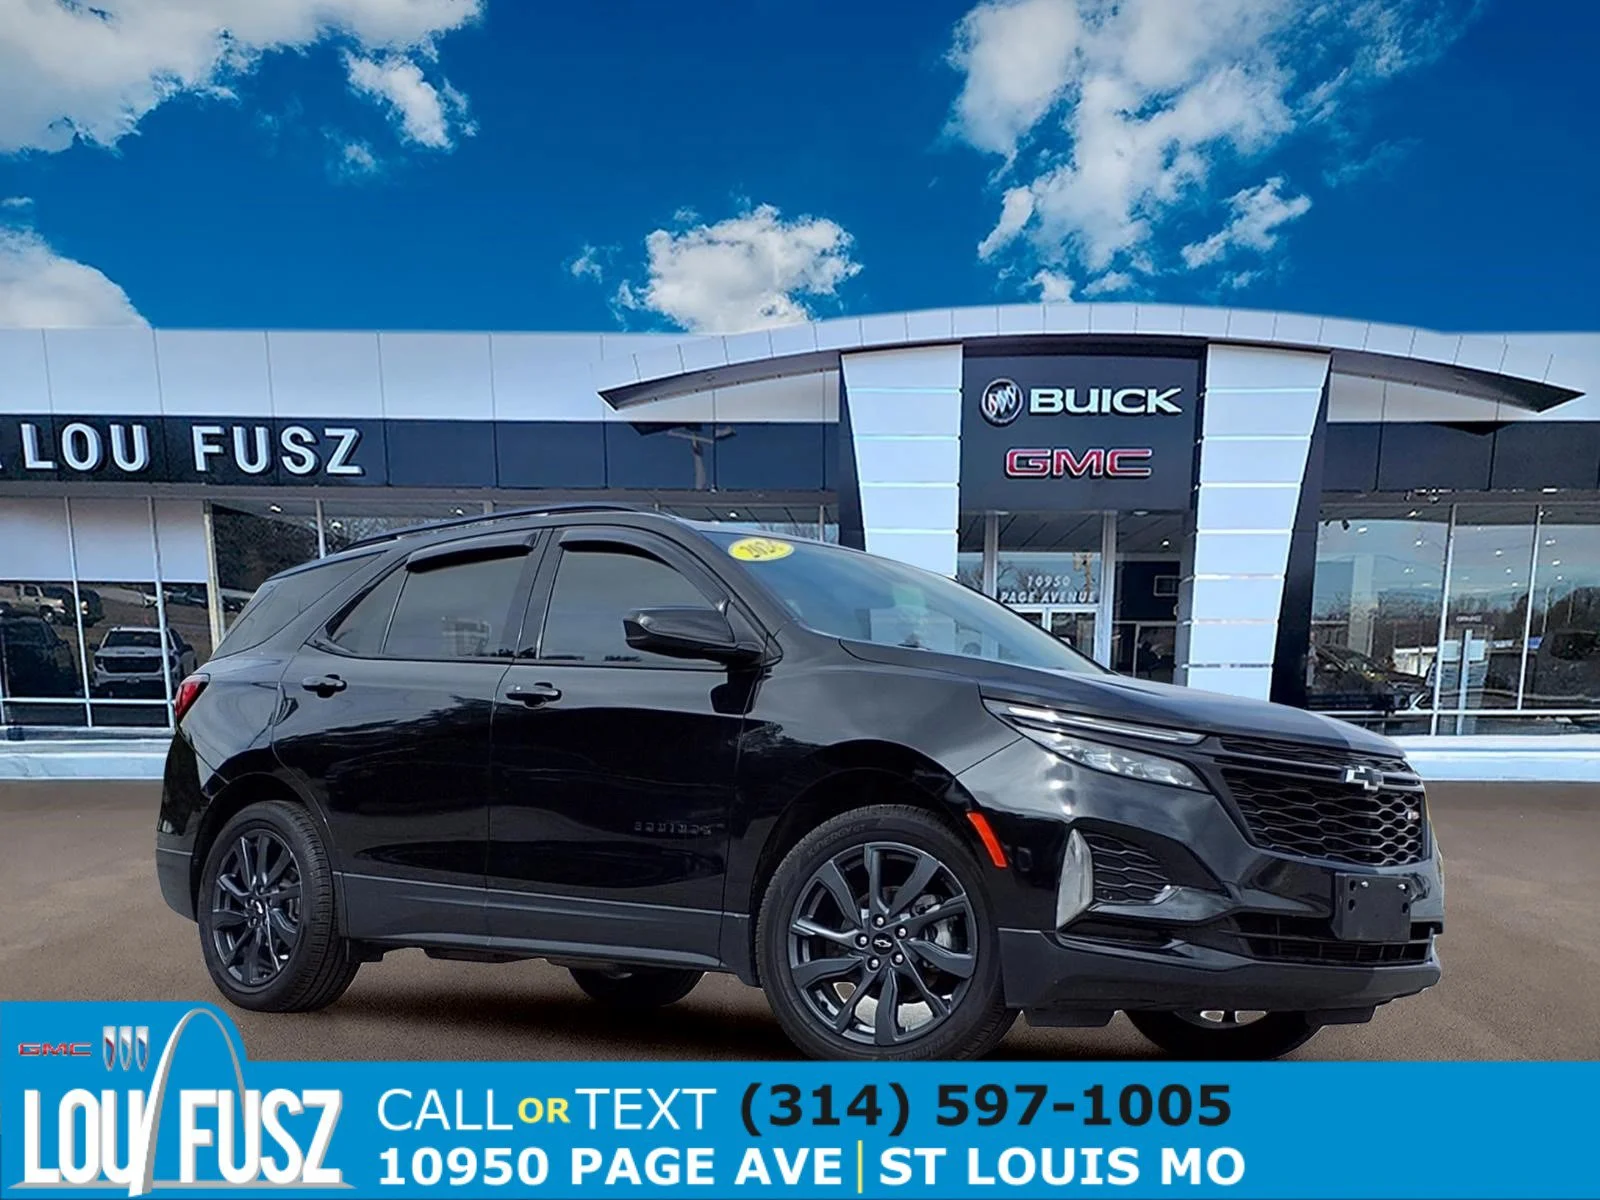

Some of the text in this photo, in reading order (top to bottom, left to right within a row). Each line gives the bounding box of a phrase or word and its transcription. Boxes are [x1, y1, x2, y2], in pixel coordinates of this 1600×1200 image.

[1030, 387, 1183, 414] BUICK
[20, 422, 363, 475] LOU FUSZ
[1005, 448, 1153, 477] GMC
[1027, 575, 1071, 588] 10950
[999, 590, 1096, 604] PAGE AVENUE
